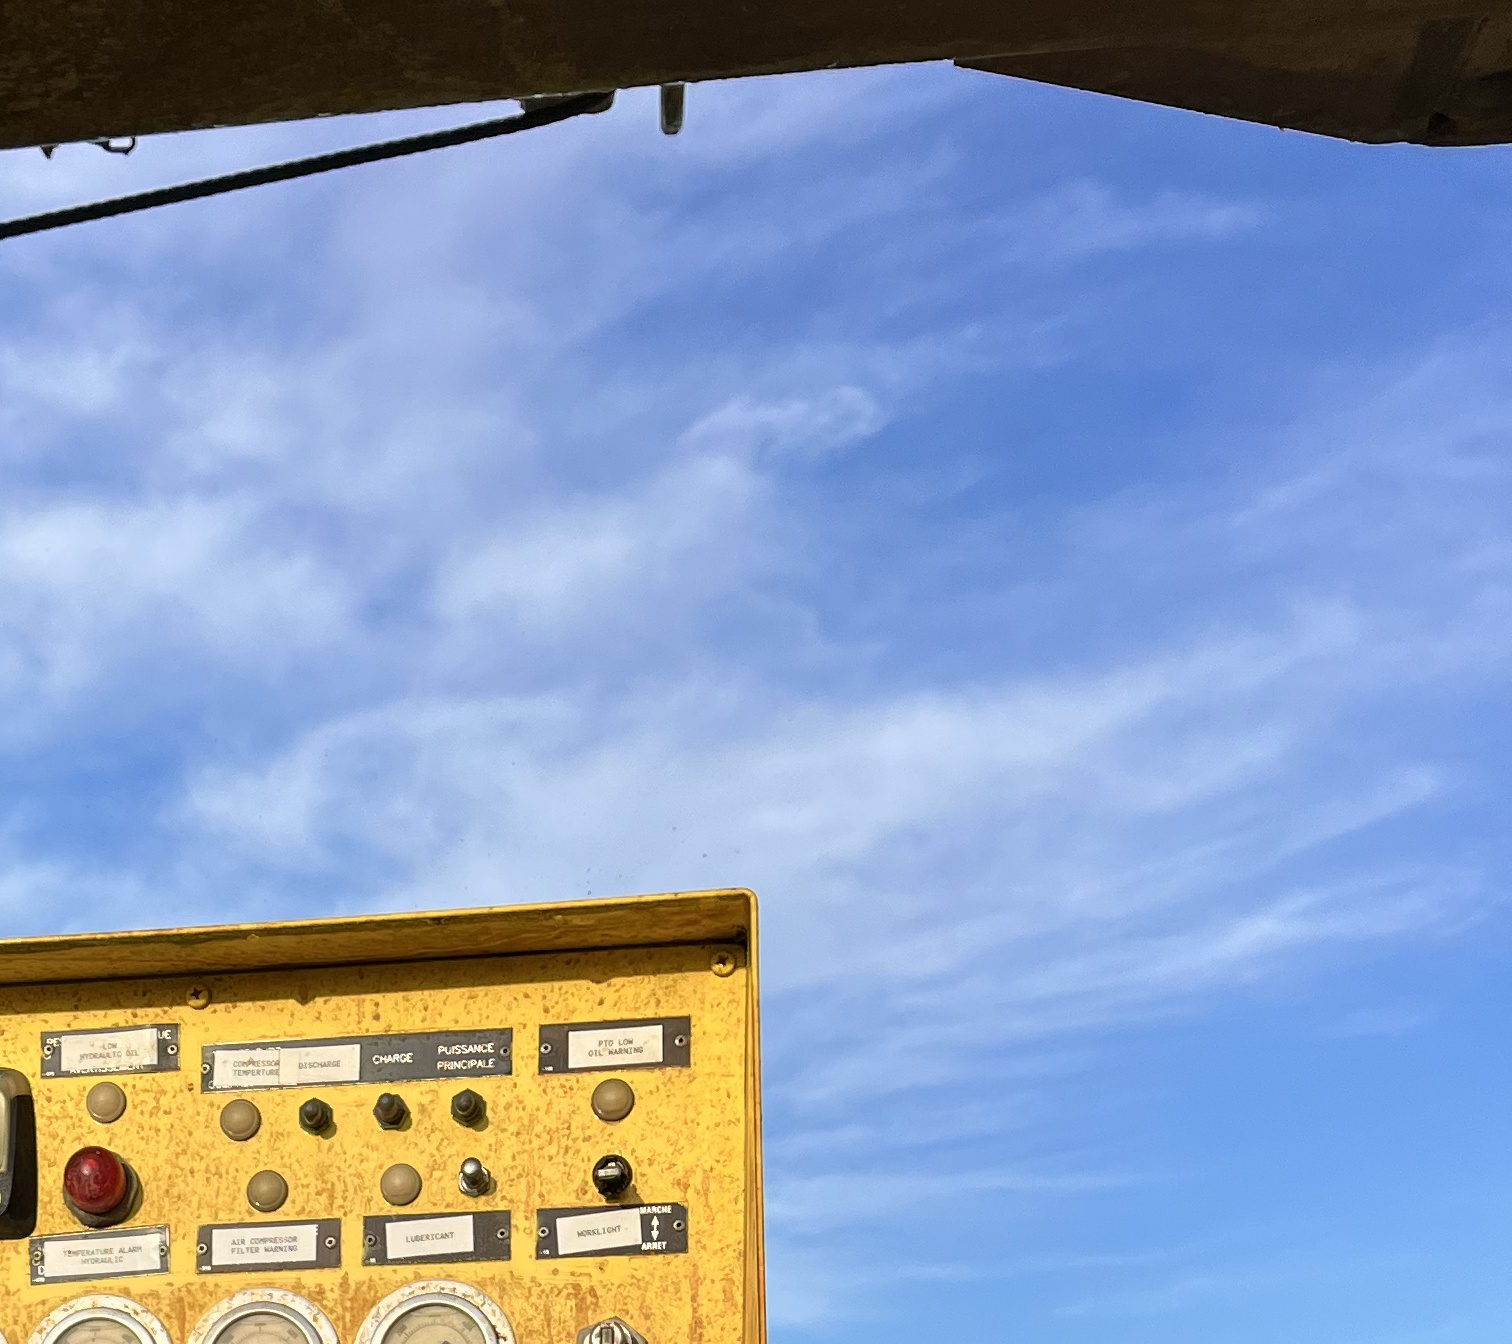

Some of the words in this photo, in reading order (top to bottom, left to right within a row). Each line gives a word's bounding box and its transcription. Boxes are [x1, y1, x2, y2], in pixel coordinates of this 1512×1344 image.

[618, 1038, 633, 1046] LOW
[438, 1043, 495, 1056] PUISSANCE
[588, 1049, 604, 1057] OIL
[608, 1046, 644, 1056] WARNING
[372, 1053, 414, 1065] CHARGE
[437, 1058, 496, 1071] PRINCIPALE
[298, 1060, 341, 1070] DISCHARGE
[639, 1205, 672, 1214] MARCHE
[405, 1231, 455, 1243] LUBERICANT
[577, 1225, 622, 1238] WORKLIGHT
[231, 1237, 246, 1246] AIR
[250, 1236, 299, 1246] COMPRESSOR
[231, 1246, 260, 1255] FILTER
[264, 1244, 299, 1253] WARNING
